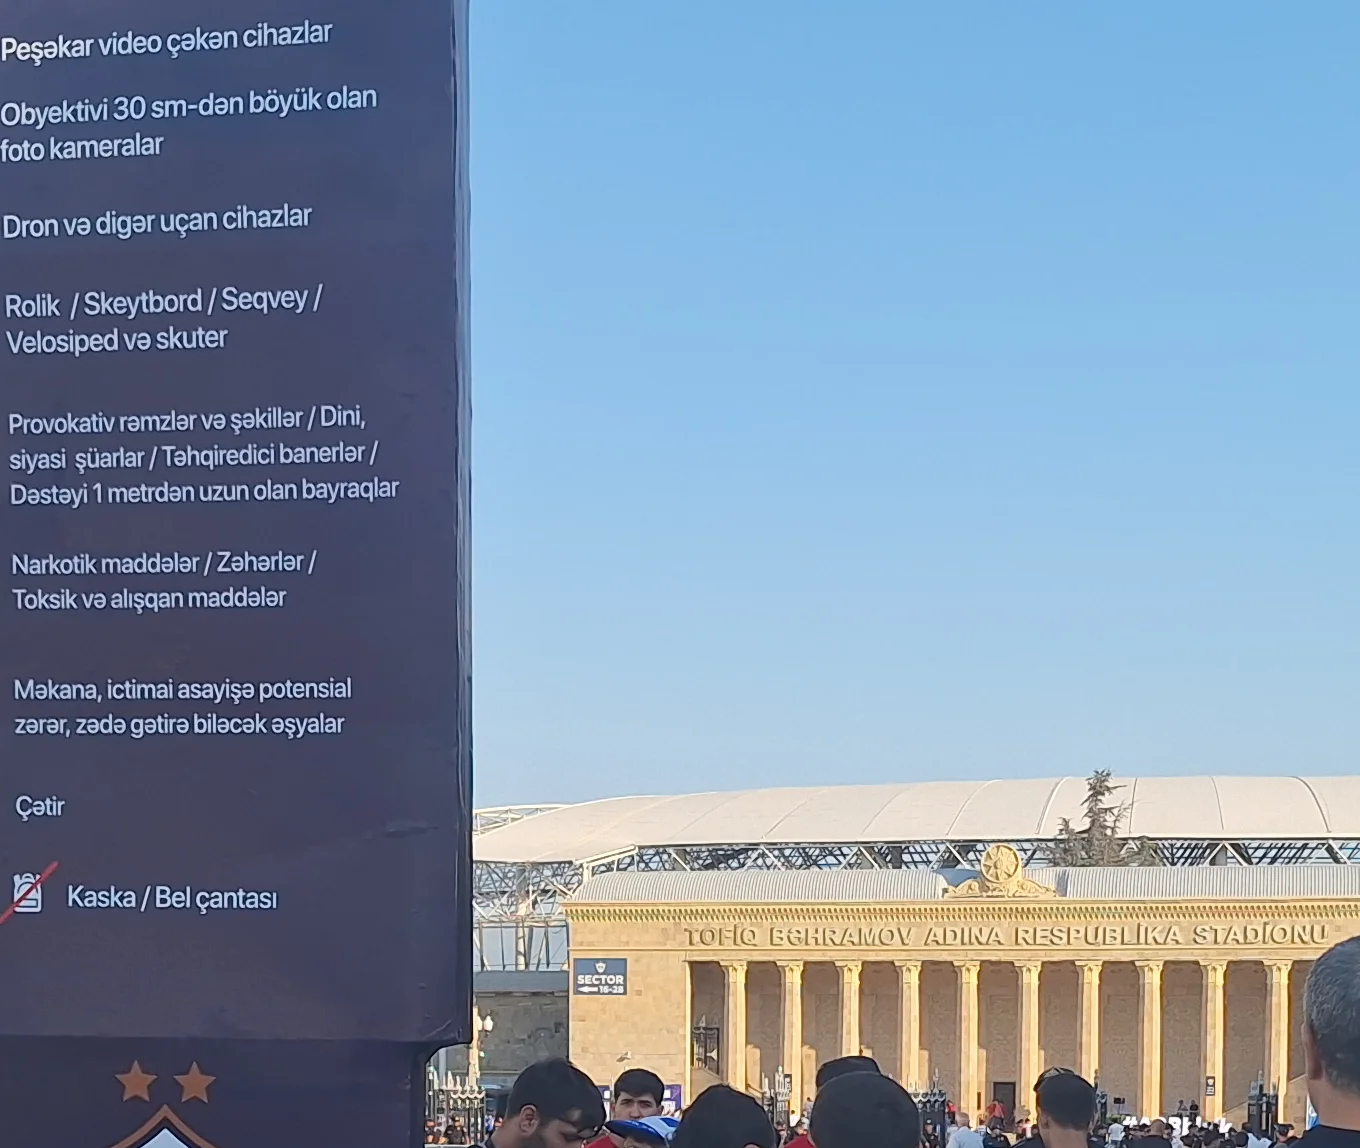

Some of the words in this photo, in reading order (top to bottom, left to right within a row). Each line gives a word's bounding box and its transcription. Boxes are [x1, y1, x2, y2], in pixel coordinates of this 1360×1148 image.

[1, 34, 95, 67] Peşəkar
[98, 30, 163, 56] video
[166, 26, 238, 59] çəkən
[242, 19, 333, 48] cihazlar
[0, 97, 109, 130] Obyektivi
[113, 95, 146, 121] 30
[151, 92, 244, 119] sm-dən
[249, 86, 322, 118] böyük
[326, 85, 377, 110] olan
[0, 138, 45, 163] foto
[49, 132, 165, 160] kameralar
[3, 214, 59, 239] Dron
[62, 217, 91, 236] və
[95, 210, 156, 240] digər
[160, 212, 218, 239] uçan
[222, 202, 313, 230] cihazlar
[5, 293, 61, 318] Rolik
[70, 292, 80, 321] /
[84, 287, 203, 320] Skeytbord
[207, 287, 217, 316] /
[221, 286, 309, 315] Seqvey
[312, 283, 323, 312] /
[5, 327, 119, 357] Velosiped
[122, 332, 152, 351] və
[156, 325, 229, 350] skuter
[9, 411, 116, 435] Provokativ
[119, 409, 198, 432] rəmzlər
[200, 413, 226, 430] və
[230, 406, 304, 435] şəkillər
[307, 405, 317, 431] /
[320, 404, 366, 430] Dini,
[9, 447, 66, 475] siyasi
[75, 446, 146, 475] şüarlar
[148, 445, 158, 471] /
[161, 442, 275, 471] Təhqiredici
[279, 440, 366, 464] banerlər
[369, 440, 379, 466] /
[10, 482, 88, 509] Dəstəyi
[92, 482, 102, 504] 1
[107, 481, 195, 503] metrdən
[199, 484, 250, 502] uzun
[253, 478, 298, 501] olan
[302, 476, 400, 504] bayraqlar
[12, 553, 98, 575] Narkotik
[101, 551, 201, 574] maddələr
[203, 551, 213, 577] /
[216, 550, 305, 572] Zəhərlər
[307, 549, 318, 575] /
[11, 588, 78, 610] Toksik
[81, 593, 107, 609] və
[110, 587, 184, 615] alışqan
[188, 585, 287, 608] maddələr
[14, 678, 103, 703] Məkana,
[107, 678, 173, 700] ictimai
[177, 678, 255, 705] asayişə
[259, 676, 352, 703] potensial
[14, 718, 71, 738] zərər,
[75, 713, 127, 734] zədə
[130, 713, 190, 739] gətirə
[193, 712, 268, 734] biləcək
[271, 712, 346, 740] əşyalar
[15, 795, 66, 822] Çətir
[68, 884, 136, 908] Kaska
[140, 885, 152, 912] /
[155, 885, 191, 908] Bel
[195, 888, 277, 915] çantası
[684, 923, 758, 947] TOFİQ
[769, 926, 915, 947] BƏHRAMOV
[924, 926, 1005, 947] ADINA
[1014, 922, 1183, 946] RESPUBLİKA
[1192, 921, 1331, 946] STADİONU
[577, 974, 625, 985] SECTOR
